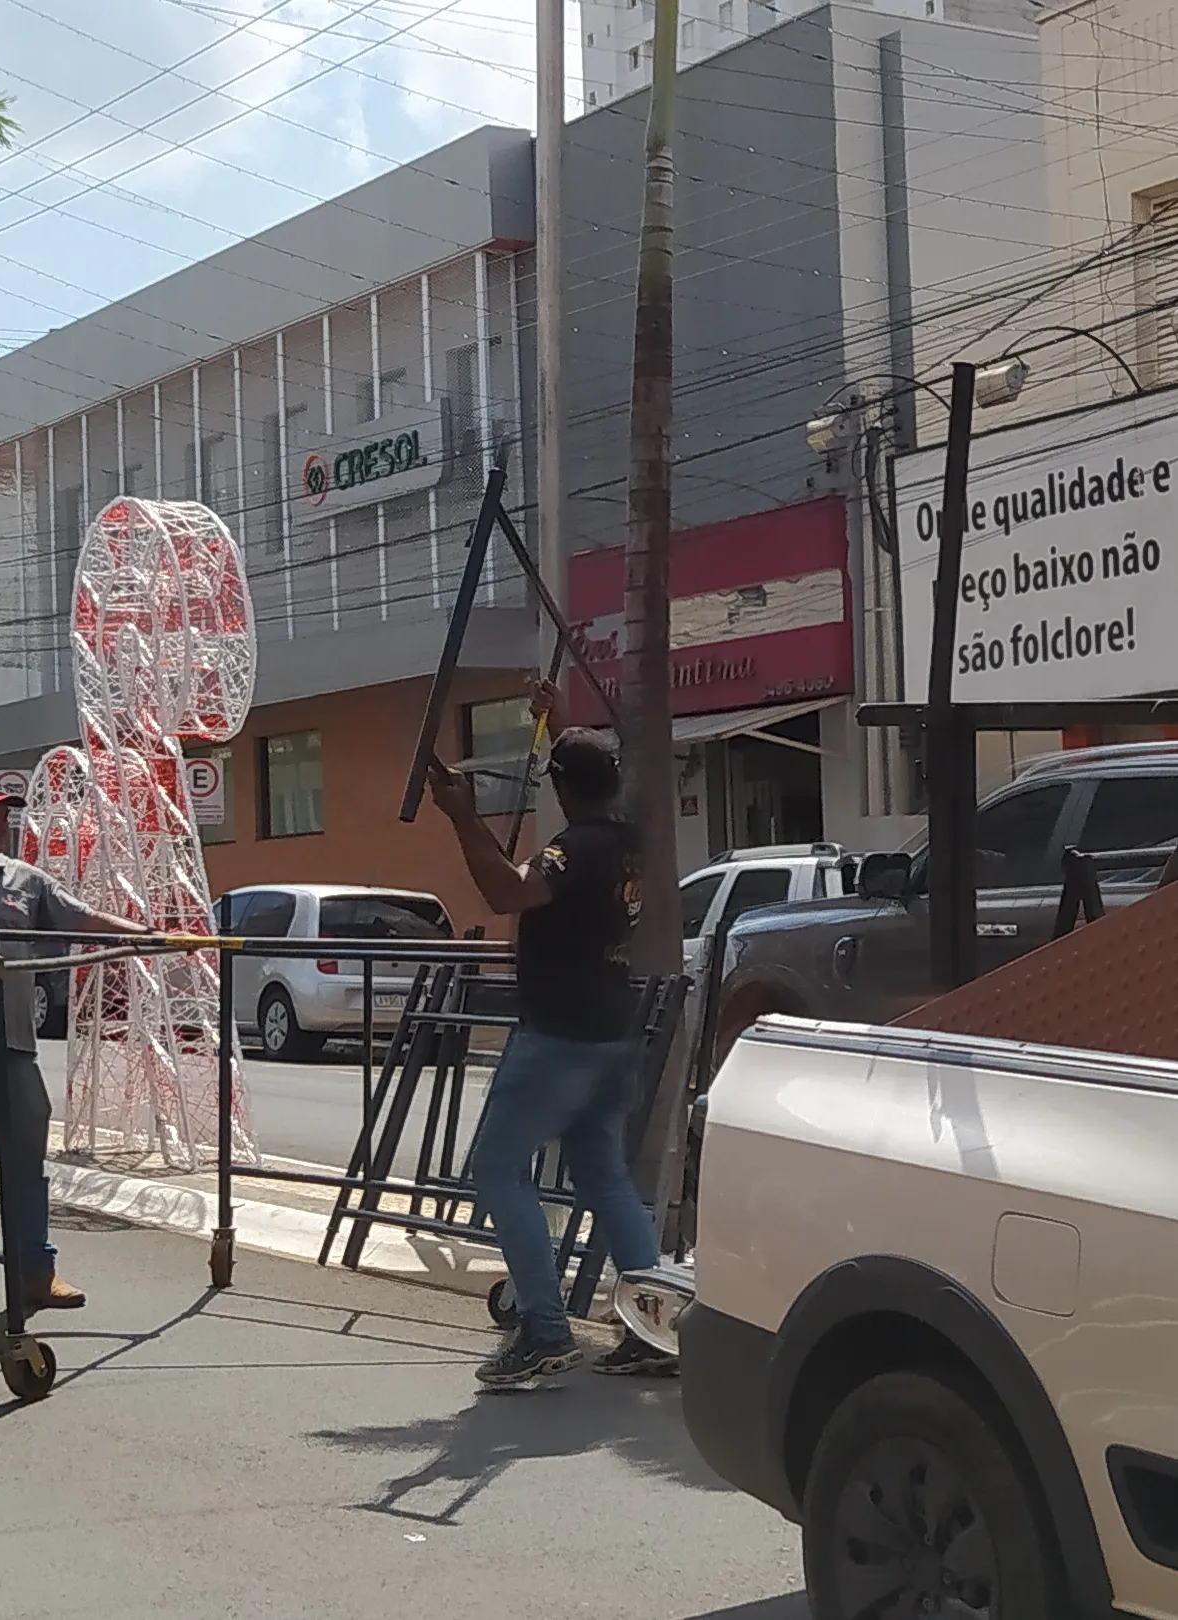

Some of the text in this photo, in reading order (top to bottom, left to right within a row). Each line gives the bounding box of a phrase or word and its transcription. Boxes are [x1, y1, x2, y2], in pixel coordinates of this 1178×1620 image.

[334, 429, 428, 490] CRESOL
[917, 457, 1171, 542] Oe qualidade e
[1014, 546, 1094, 595] baixo
[1102, 531, 1161, 580] não
[958, 607, 1136, 674] são folclore!
[193, 769, 208, 788] E
